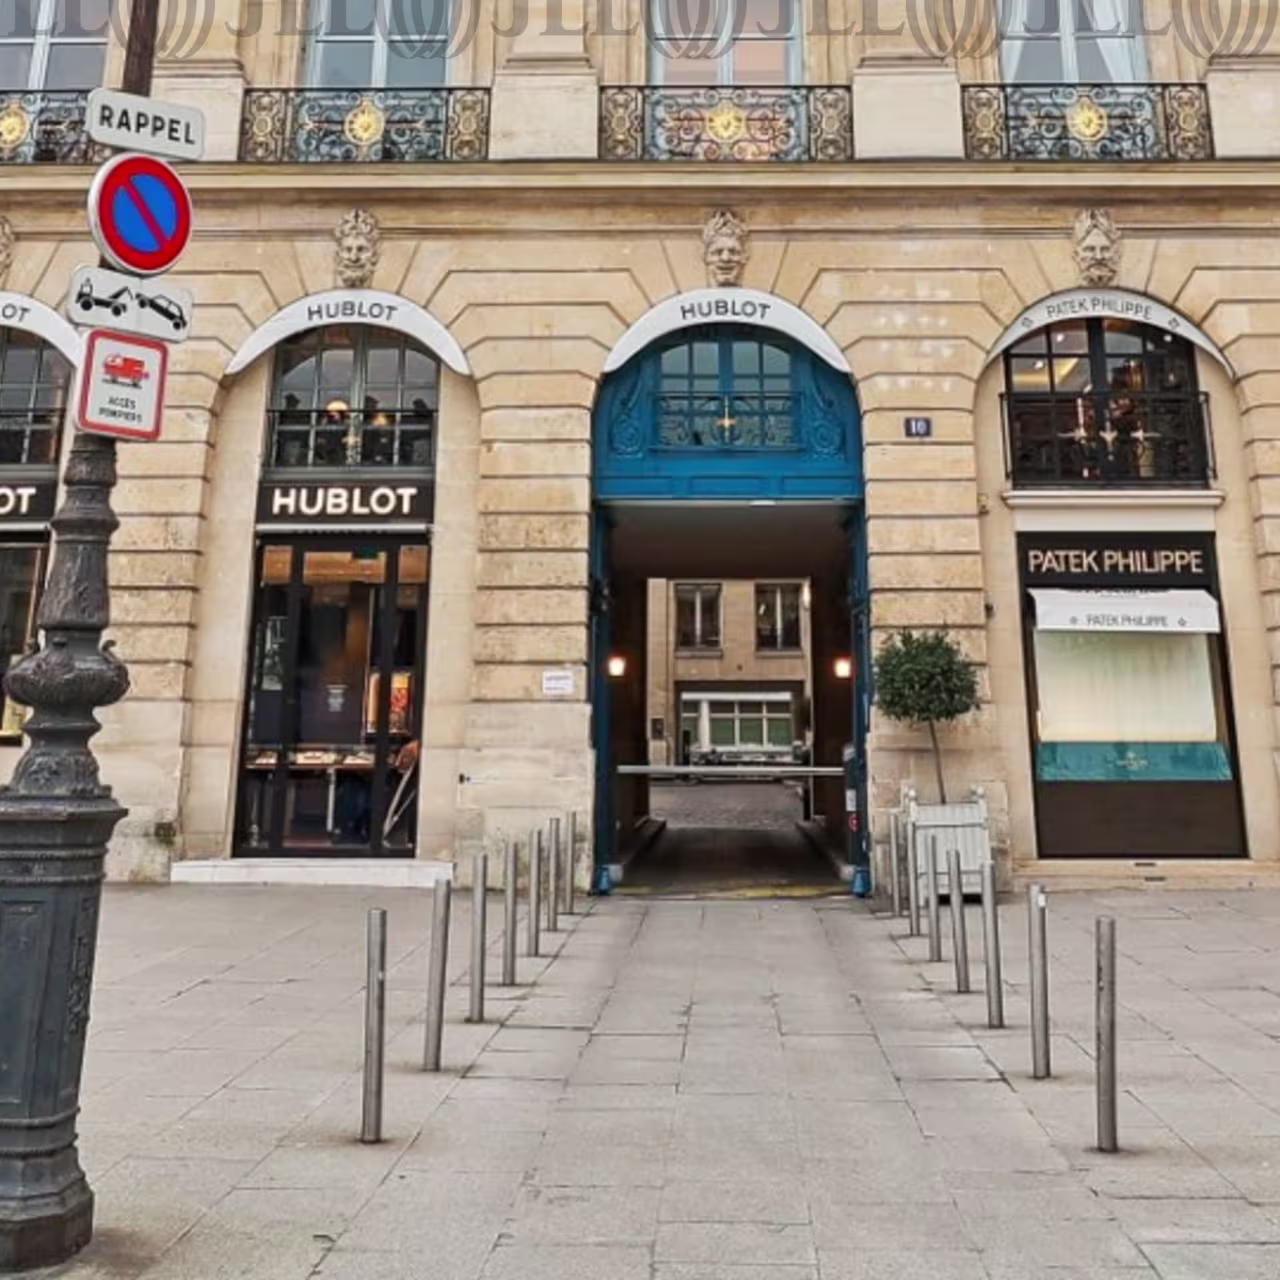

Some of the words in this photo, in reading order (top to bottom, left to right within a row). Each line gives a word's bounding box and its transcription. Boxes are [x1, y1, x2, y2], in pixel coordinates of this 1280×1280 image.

[99, 104, 195, 145] RAPPEL
[308, 301, 398, 321] HUBLOT
[680, 299, 771, 320] HUBLOT
[1046, 298, 1089, 318] PATEK
[1091, 297, 1152, 320] PHILIPPE
[272, 487, 418, 515] HUBLOT
[1028, 550, 1099, 573] PATEK
[1103, 550, 1203, 573] PHILIPPE
